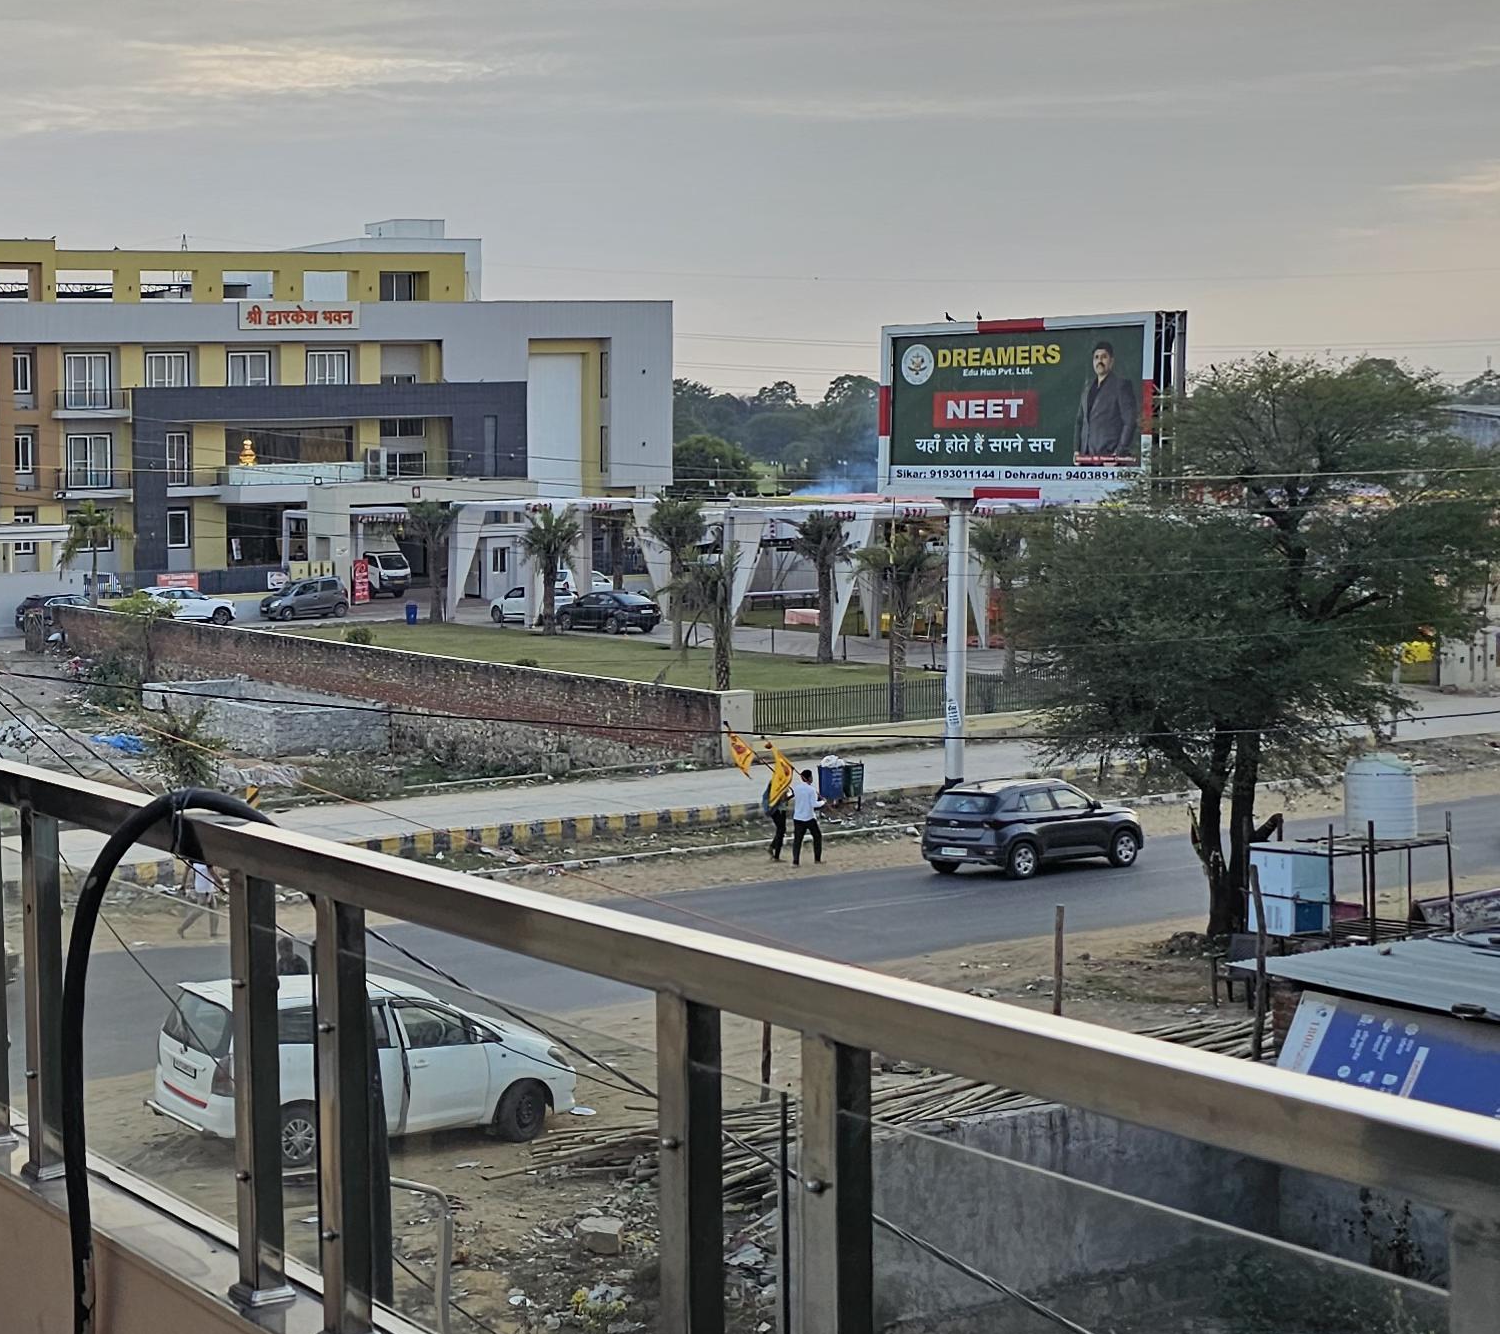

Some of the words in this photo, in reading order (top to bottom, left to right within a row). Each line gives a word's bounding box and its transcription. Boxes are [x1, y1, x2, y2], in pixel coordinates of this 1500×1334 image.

[246, 304, 262, 325] श्री
[265, 304, 319, 326] द्वारकेश
[322, 310, 353, 324] भवन
[937, 344, 1061, 368] DREAMERS
[962, 368, 978, 377] Edu
[980, 368, 997, 376] Hub
[999, 367, 1015, 376] Pvt.
[1016, 367, 1033, 375] Ltd.
[946, 398, 1024, 420] NEET
[914, 433, 941, 454] यहाँ
[944, 433, 970, 454] होते
[973, 432, 985, 454] हैं
[988, 433, 1024, 453] सपने
[1027, 437, 1056, 453] सच
[896, 469, 927, 479] Sikar:
[929, 469, 995, 479] 9193011144
[1004, 470, 1062, 480] Dehradun:
